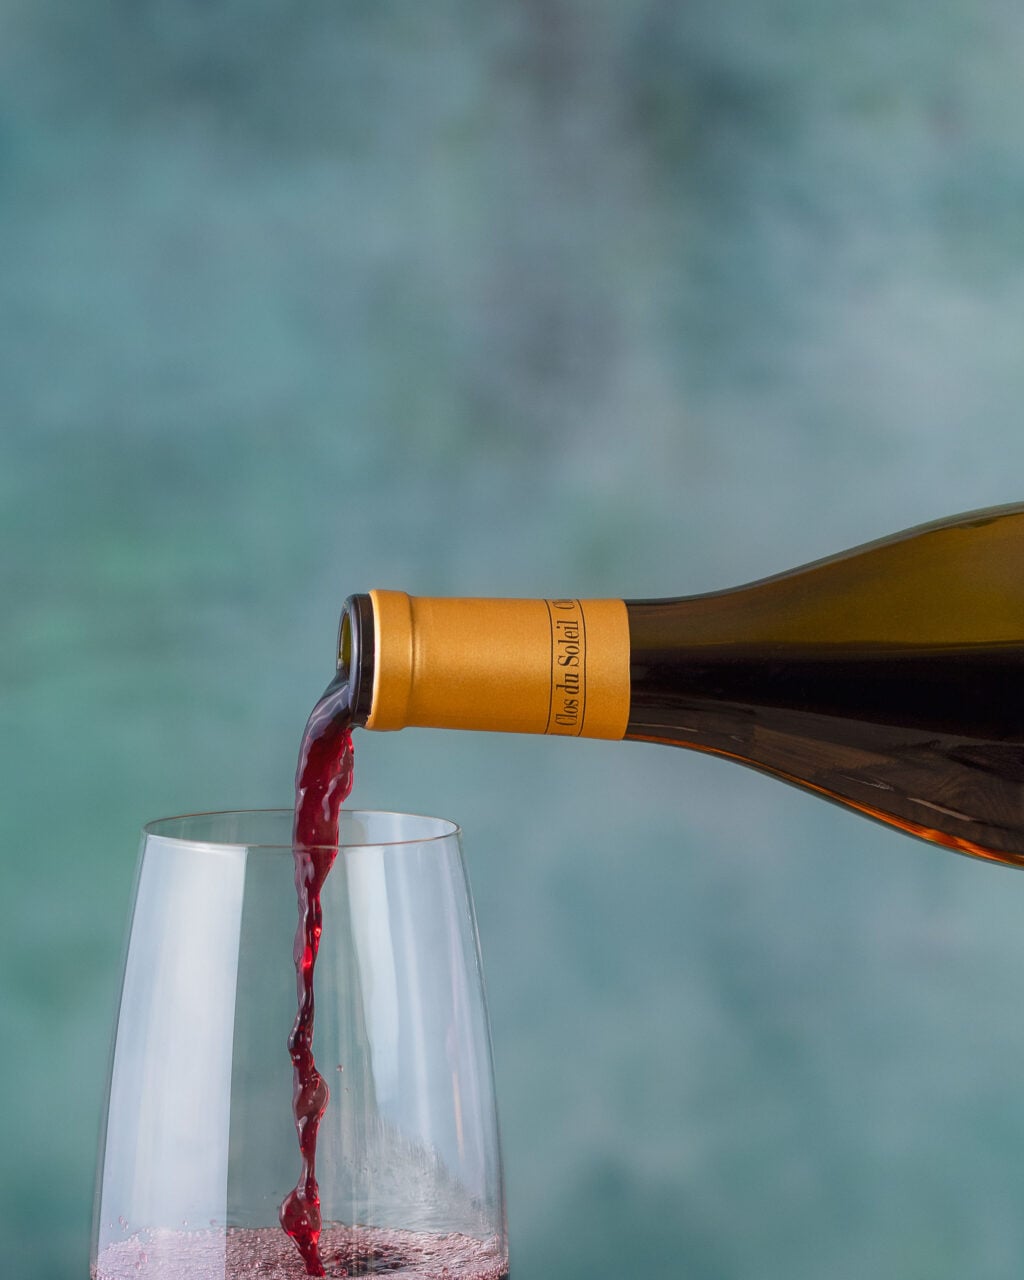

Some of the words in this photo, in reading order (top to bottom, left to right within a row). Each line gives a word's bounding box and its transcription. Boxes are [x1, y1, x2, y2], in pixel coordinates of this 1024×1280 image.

[556, 620, 580, 667] Soleil
[556, 673, 579, 695] du
[555, 699, 579, 727] Clos
